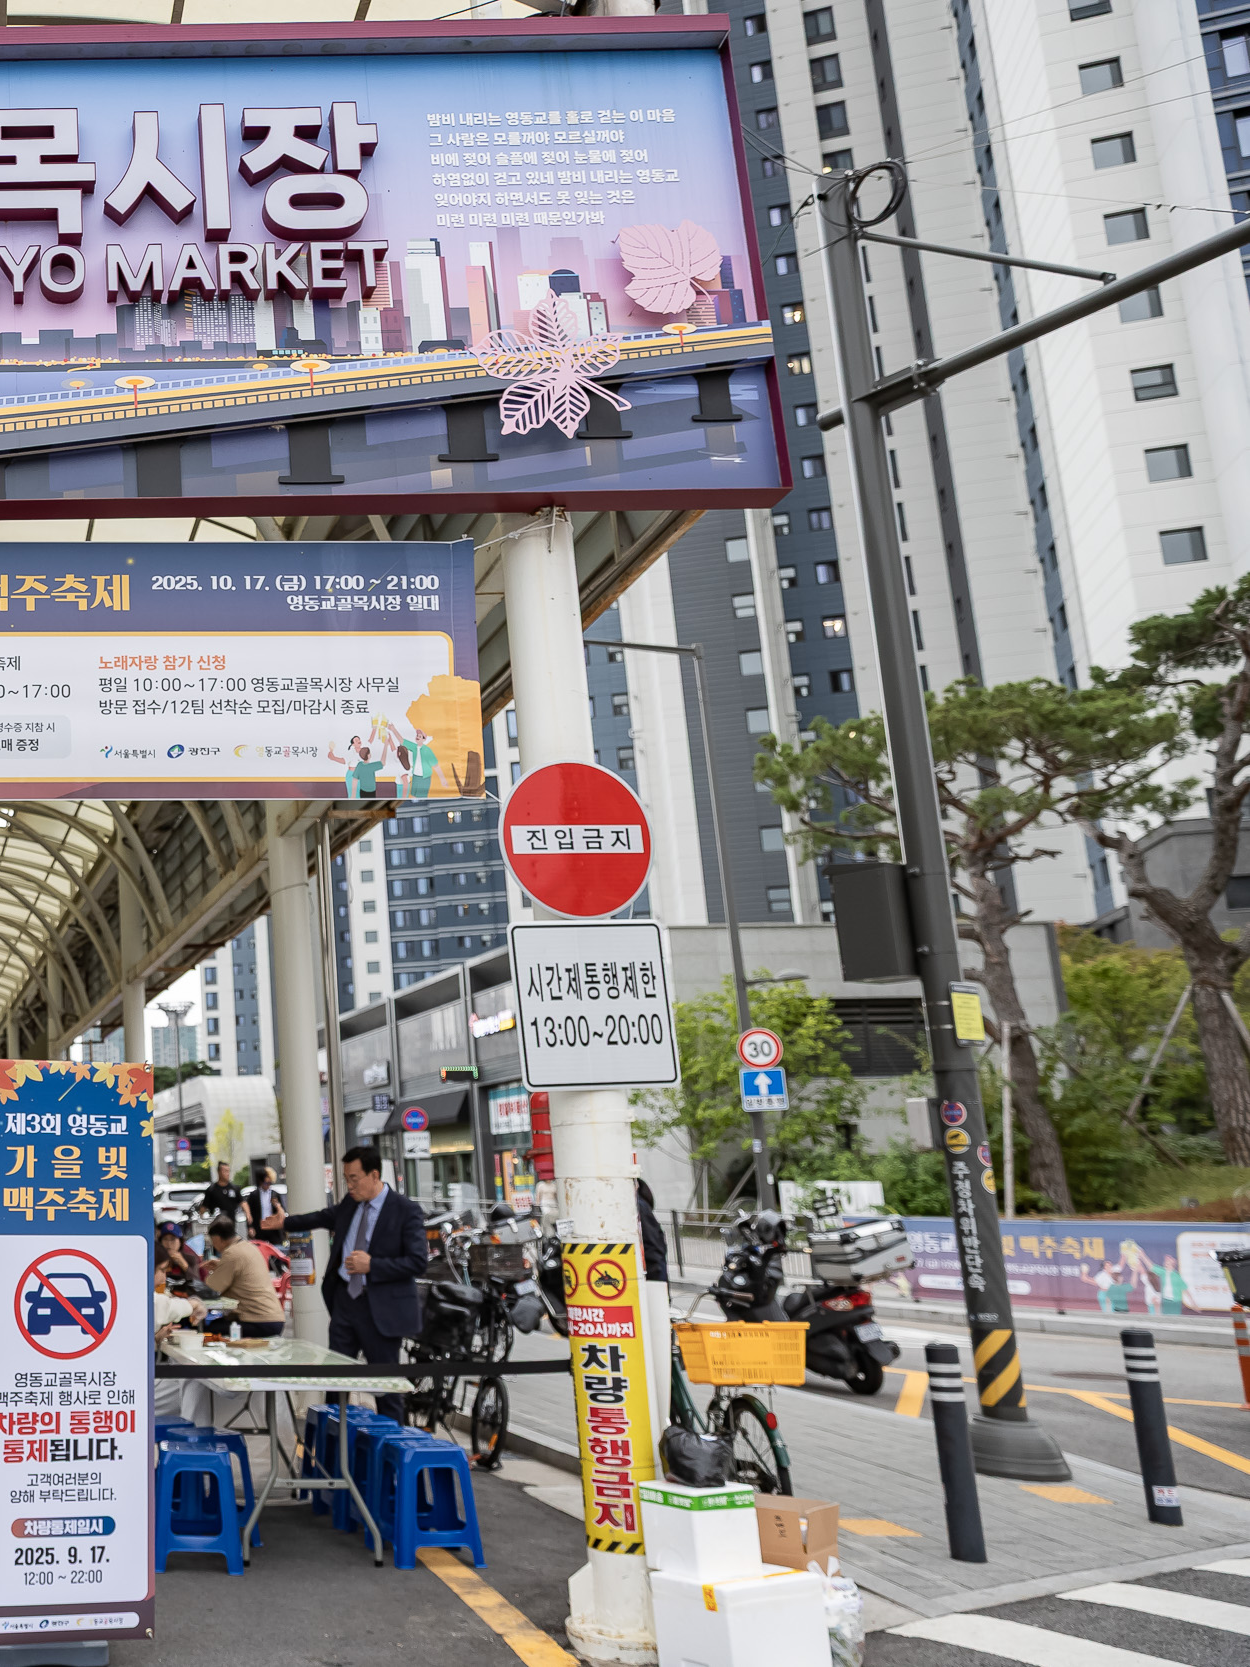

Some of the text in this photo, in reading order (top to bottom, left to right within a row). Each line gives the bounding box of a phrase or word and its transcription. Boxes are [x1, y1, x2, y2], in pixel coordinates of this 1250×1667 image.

[427, 113, 455, 127] 밤비
[459, 113, 501, 126] 내리는
[505, 111, 561, 125] 영동교를
[598, 110, 626, 123] 걷는
[629, 110, 643, 122] 이
[647, 109, 675, 122] 마음
[430, 134, 443, 146] 그
[447, 132, 489, 146] 사람은
[431, 149, 648, 167] 비에 젖어 슬픔에 젖어 눈물에 젖어
[433, 169, 679, 187] 하염없이 걷고 있네 밤비 내리는 영동교
[435, 190, 635, 207] 잊어야지 하면서도 못 잊는 것은
[436, 211, 604, 228] 미련 미련 미련 때문인가봐
[106, 239, 389, 304] MARKET
[152, 575, 203, 591] 2025.
[210, 575, 236, 591] 10.
[244, 575, 269, 591] 17.
[275, 575, 307, 591] (금)
[313, 575, 364, 591] 17:00
[387, 575, 439, 591] 21:00
[287, 595, 439, 611] 영동교골목시장 일대
[99, 655, 226, 671] 노래자랑 참가 신청
[99, 676, 400, 692] 평일 10:00~17:00 영동교골목시장 사무실
[99, 699, 369, 715] 방문 접수/12팀 선착순 모집/마감시 종료
[25, 722, 43, 733] 지참
[46, 722, 55, 733] 시
[16, 738, 39, 752] 증정
[114, 748, 156, 759] 서울특별시
[188, 747, 220, 756] 광진구
[526, 828, 631, 851] 진입금지
[528, 961, 657, 1001] 시간제통행제한
[530, 1013, 663, 1048] 13:00~20:00
[748, 1040, 772, 1058] 30
[5, 1113, 129, 1136] 제3회 영동교
[3, 1187, 130, 1221] 맥주축제
[14, 1371, 116, 1388] 영동교골목시장
[59, 1390, 101, 1406] 행사로
[108, 1389, 135, 1405] 인해
[69, 1409, 135, 1434] 통행이
[580, 1343, 639, 1533] 차량통행금지
[3, 1438, 123, 1463] 통제됩니다.
[26, 1472, 101, 1487] 고객여러분의
[10, 1488, 116, 1503] 양해 부탁드립니다.
[24, 1519, 103, 1536] 차량통제일시
[14, 1546, 110, 1566] 2025. 9. 17.
[24, 1570, 53, 1586] 12:00
[71, 1570, 102, 1584] 22:00
